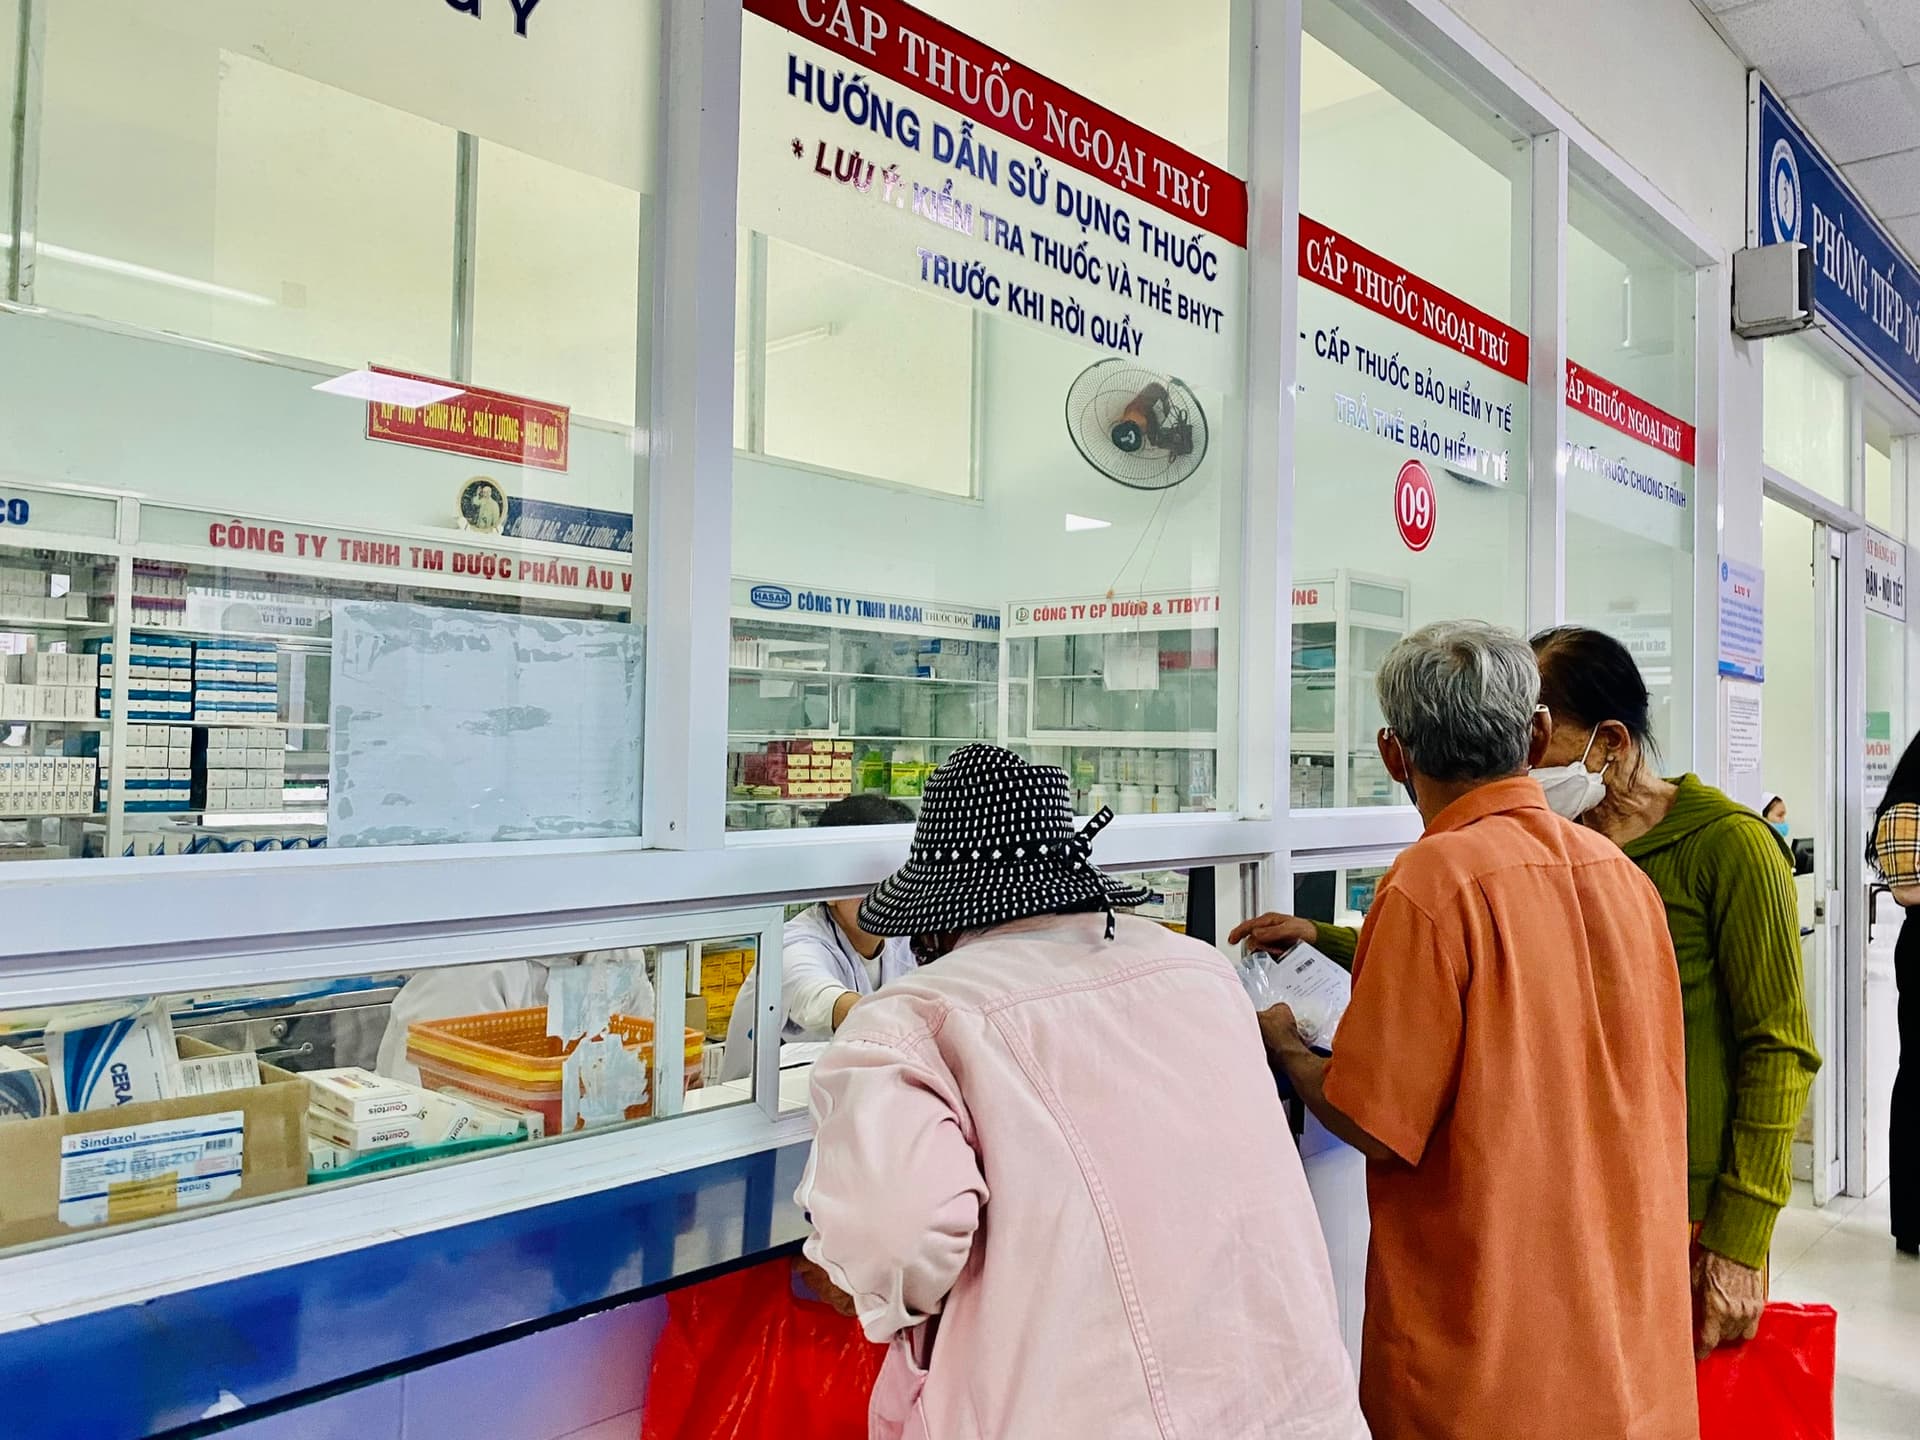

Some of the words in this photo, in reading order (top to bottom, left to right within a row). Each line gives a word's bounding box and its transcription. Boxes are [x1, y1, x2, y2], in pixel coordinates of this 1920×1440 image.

[899, 26, 1034, 132] THUỐC
[1044, 99, 1146, 190] NGOẠI
[1153, 160, 1211, 218] TRÚ
[787, 54, 921, 152] HƯỚNG
[932, 119, 998, 186] DẪN
[1008, 157, 1050, 206] SỬ
[1057, 181, 1130, 243] DỤNG
[1138, 219, 1217, 282] THUỐC
[814, 140, 875, 193] LƯU
[979, 210, 1024, 256] TRA
[1031, 231, 1101, 285] THUỐC
[1107, 263, 1132, 298] VÀ
[1137, 276, 1173, 315] THẺ
[1178, 295, 1224, 334] BHYT
[917, 247, 1000, 307] TRƯỚC
[1008, 283, 1044, 322] KHI
[1051, 296, 1085, 337] RỜI
[1091, 315, 1144, 358] QUẦY
[1306, 234, 1349, 285] CẤP
[1353, 261, 1419, 322] THUỐC
[1423, 297, 1477, 353] NGOẠI
[1479, 331, 1510, 367] TRÚ
[1811, 203, 1868, 315] PHÒNG
[1871, 263, 1903, 344] TIẾP
[1315, 326, 1350, 365] CẤP
[1355, 345, 1410, 390] THUỐC
[1415, 367, 1445, 405] BẢO
[1449, 380, 1481, 420] HIỂM
[1484, 401, 1494, 424] Y
[1496, 402, 1512, 433] TẾ
[1566, 367, 1584, 404] ẤP
[1586, 383, 1626, 426] THUỐC
[1627, 405, 1660, 447] NGOẠI
[1661, 424, 1682, 452] TRÚ
[449, 401, 467, 434] XÁC
[473, 401, 493, 438] CHẤT
[494, 413, 519, 448] LƯỢNG
[1334, 392, 1370, 431] TRẢ
[1373, 408, 1404, 444] THẺ
[1409, 419, 1440, 456] BẢO
[1444, 431, 1477, 473] HIỂM
[1480, 449, 1490, 475] Y
[1401, 481, 1429, 530] 09
[208, 518, 284, 553] CÔNG
[295, 532, 328, 558] TY
[338, 538, 400, 567] TNHH
[408, 547, 444, 571] TM
[452, 551, 512, 580] DƯỢC
[585, 565, 613, 590] ÂU
[753, 591, 790, 602] HASAN
[797, 590, 832, 613] CÔNG
[836, 597, 851, 614] TY
[856, 600, 886, 619] TNHH
[971, 613, 1001, 631] PHAR
[1033, 604, 1066, 622] CÔNG
[1070, 605, 1086, 620] TY
[1090, 602, 1107, 619] CP
[1152, 602, 1162, 615] &
[1167, 596, 1210, 614] TTBYT
[110, 1062, 134, 1106] CERA
[368, 1103, 408, 1115] Courtois
[80, 1132, 137, 1149] Sindazol
[371, 1129, 410, 1143] Courtois
